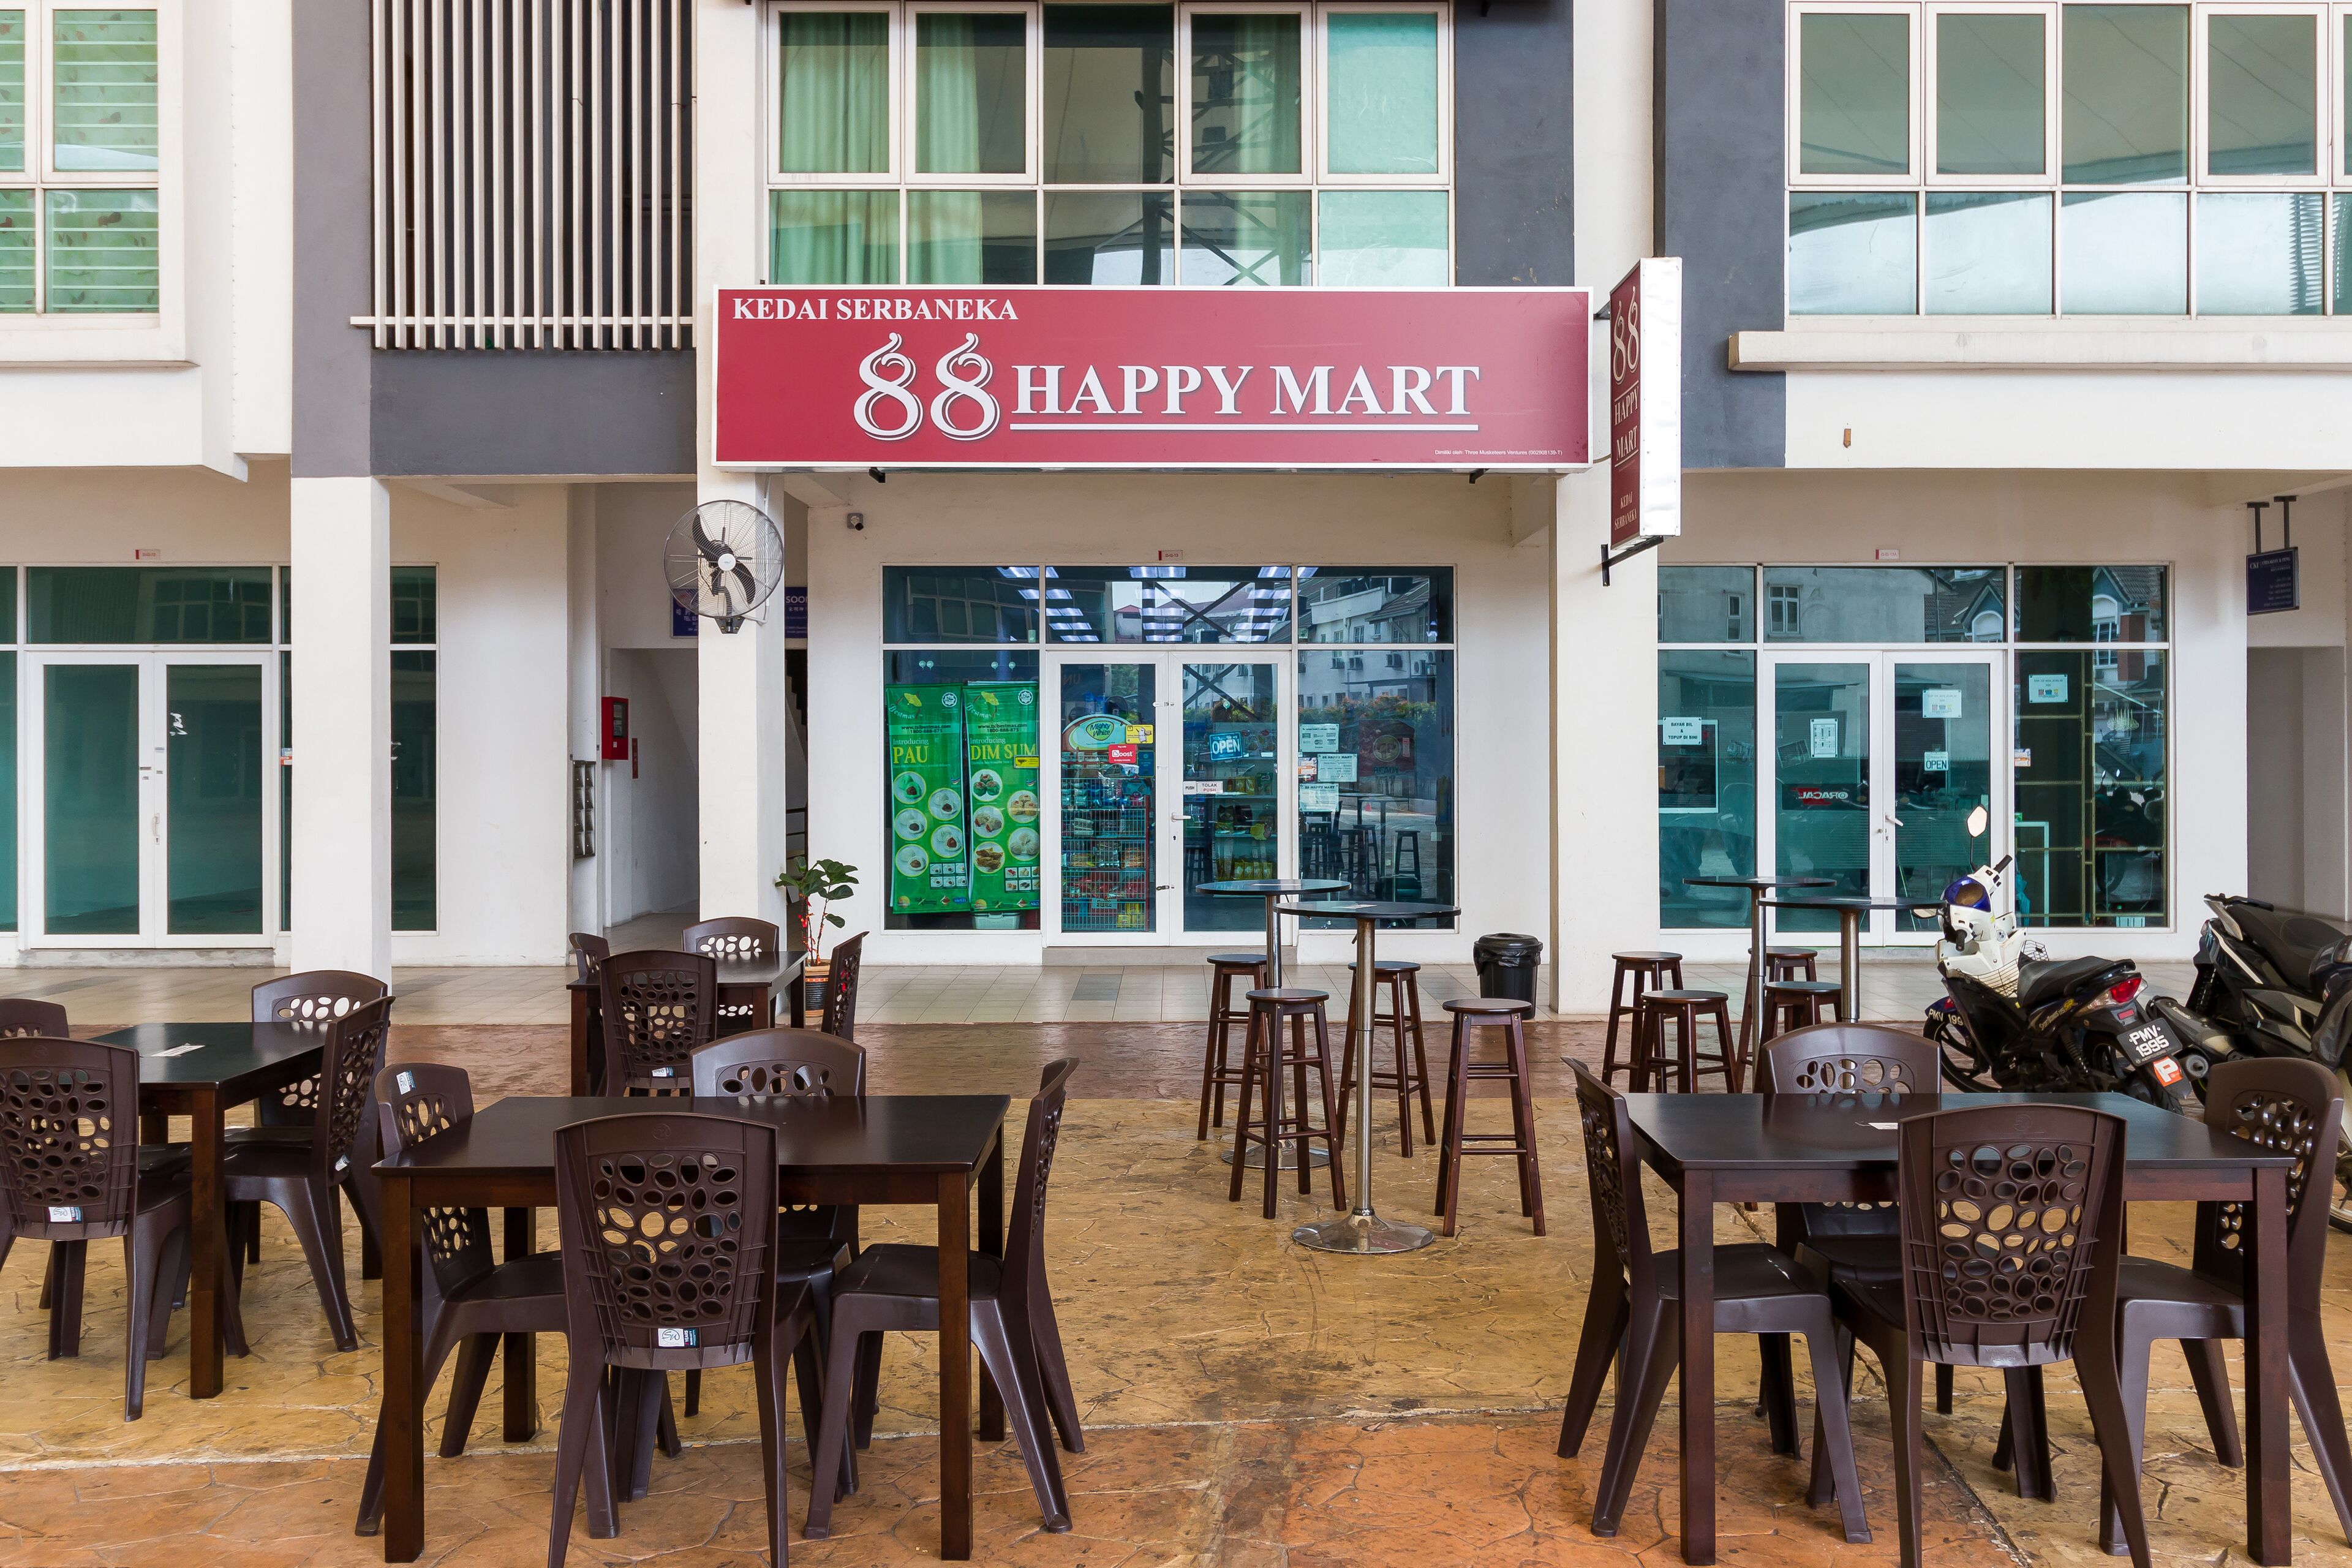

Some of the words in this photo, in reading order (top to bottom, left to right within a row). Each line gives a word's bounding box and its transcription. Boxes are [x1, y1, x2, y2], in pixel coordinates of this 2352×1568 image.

[733, 298, 828, 320] KEDAI
[836, 298, 1019, 320] SERBANEKA
[1613, 285, 1639, 386] 88
[853, 331, 1001, 442] 88
[1011, 365, 1254, 415] HAPPY
[1270, 365, 1480, 415] MART
[1615, 386, 1639, 426] HAPPY
[1616, 425, 1638, 461] MART
[1620, 491, 1633, 510] KEDAI
[1614, 508, 1637, 530] SERBANEKA
[1090, 722, 1111, 732] Mighty
[1093, 728, 1111, 737] White
[893, 746, 929, 764] PAU
[971, 744, 1000, 760] DIM
[1004, 743, 1036, 760] SUM
[1212, 739, 1240, 755] OPEN
[1926, 760, 1947, 769] OPEN
[1928, 1008, 1944, 1022] PMV
[1948, 1014, 1964, 1027] 199
[2129, 1025, 2158, 1046] PMV
[2135, 1035, 2169, 1057] 1995
[2154, 1058, 2179, 1083] P
